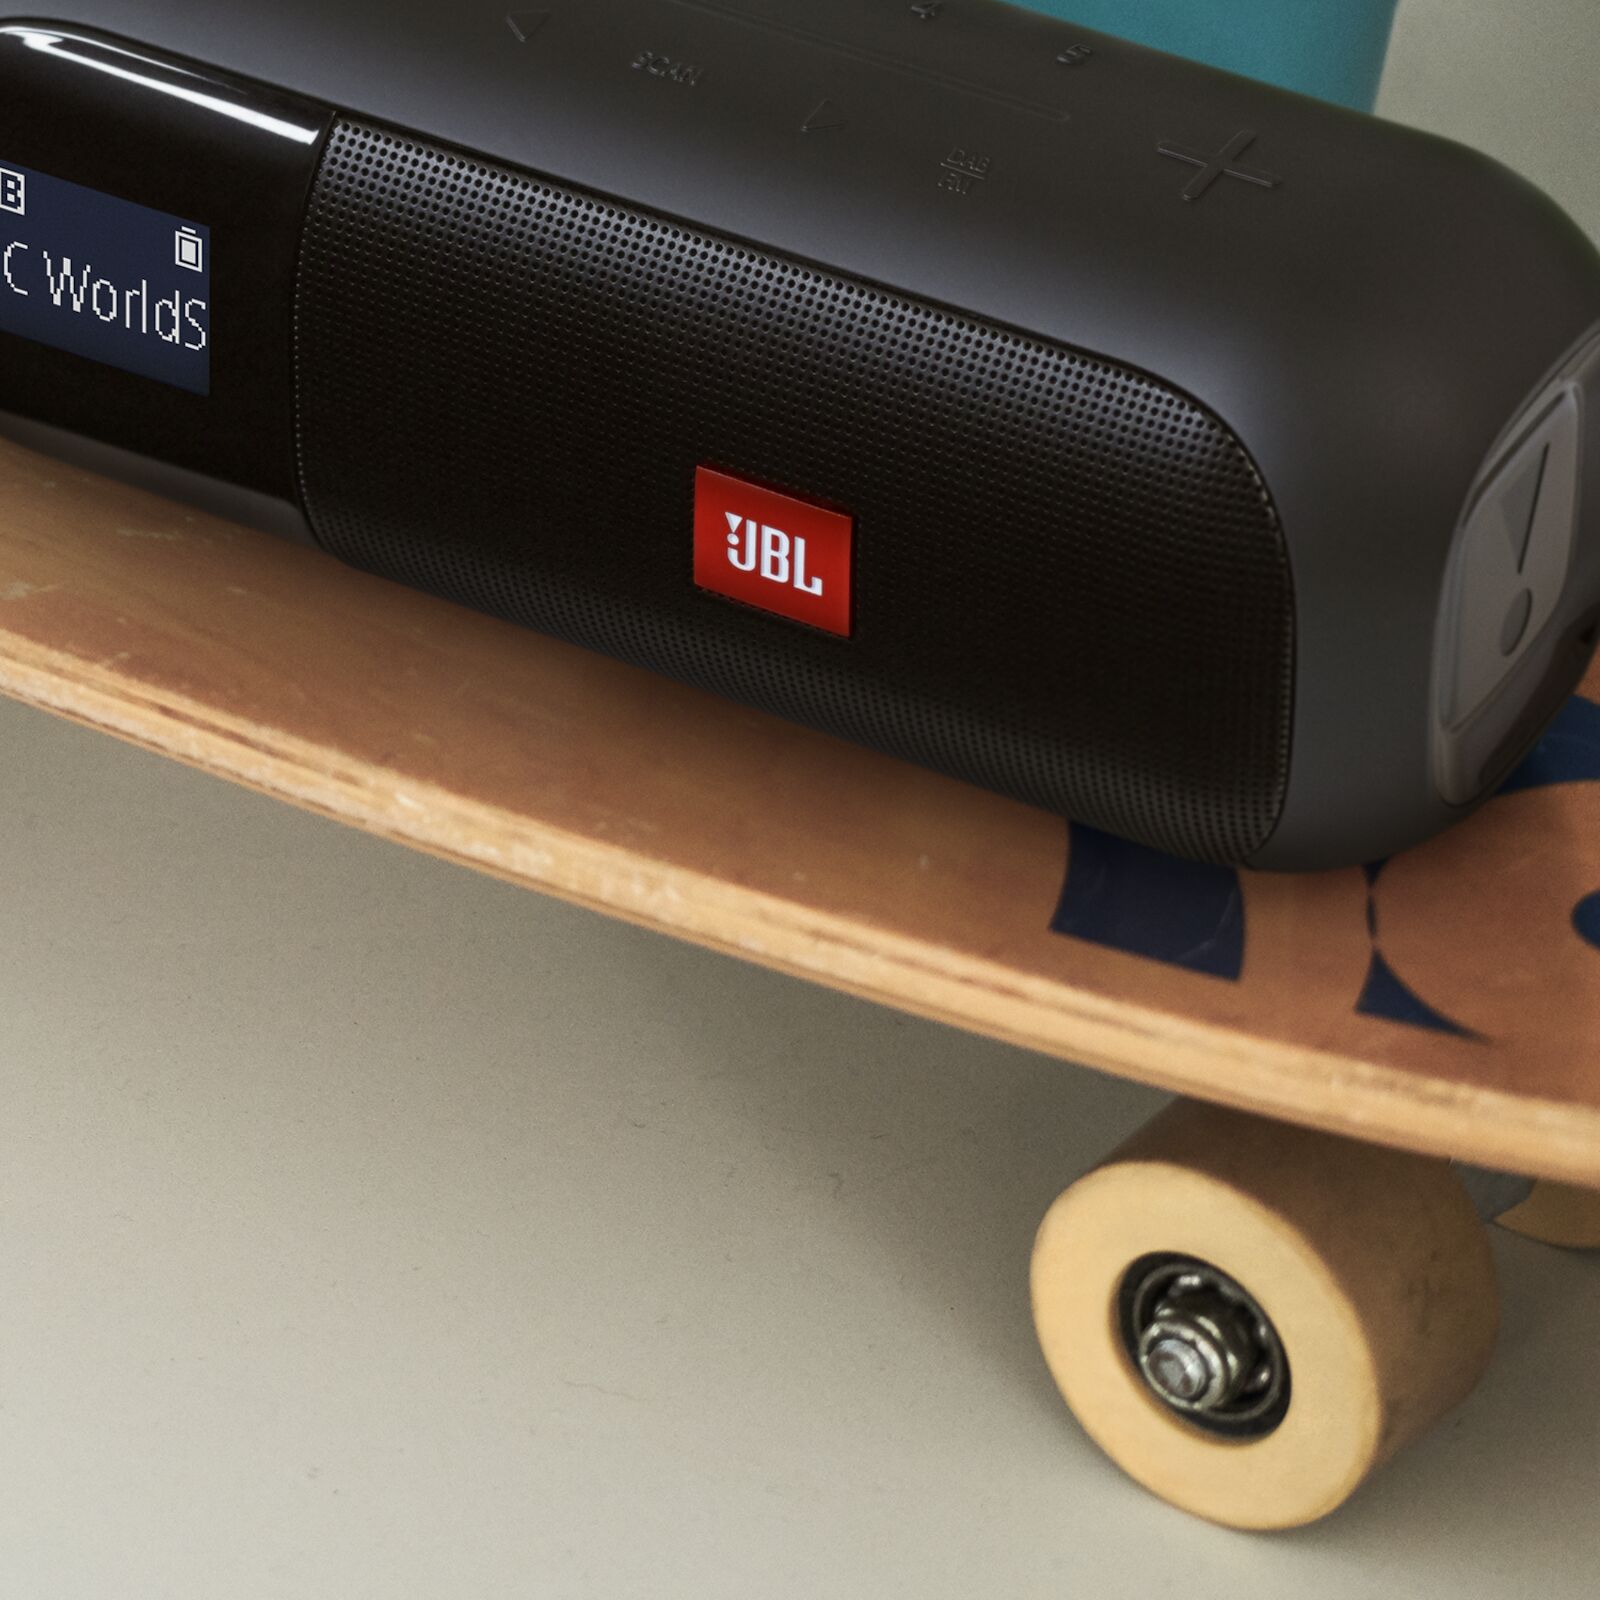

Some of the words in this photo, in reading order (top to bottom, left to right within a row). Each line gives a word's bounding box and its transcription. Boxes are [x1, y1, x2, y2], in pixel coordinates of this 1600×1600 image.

[910, 1, 941, 20] 4
[1055, 42, 1094, 66] 5
[630, 49, 703, 87] SCAN
[944, 146, 991, 174] DAB
[725, 511, 823, 597] JBL
